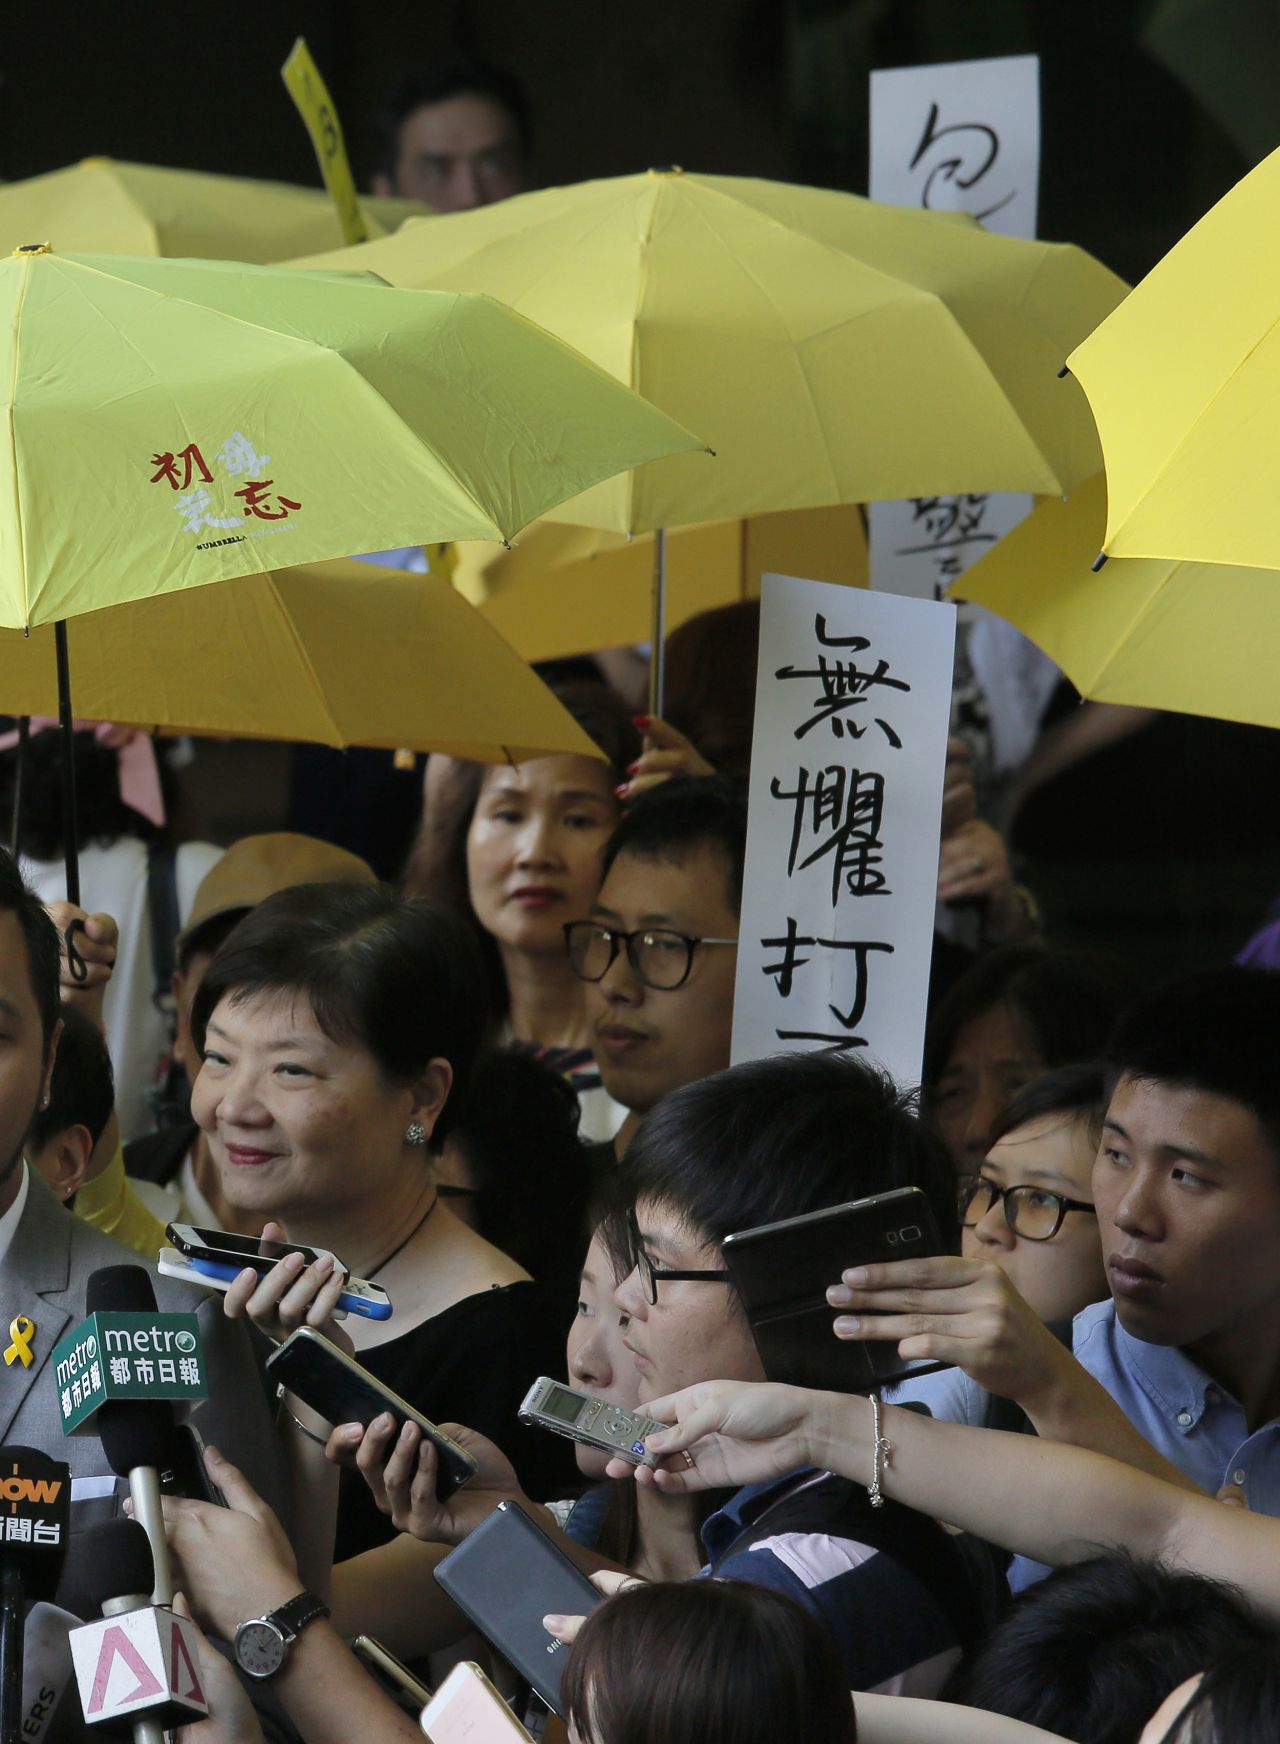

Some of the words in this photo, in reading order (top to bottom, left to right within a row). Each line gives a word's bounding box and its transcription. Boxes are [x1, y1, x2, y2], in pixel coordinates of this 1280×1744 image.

[760, 613, 910, 1052] 無懼打
[57, 1335, 97, 1387] metro
[105, 1326, 196, 1353] metro
[61, 1360, 102, 1419] 都市日報
[109, 1356, 201, 1386] 都市日報
[22, 1686, 56, 1743] ERS
